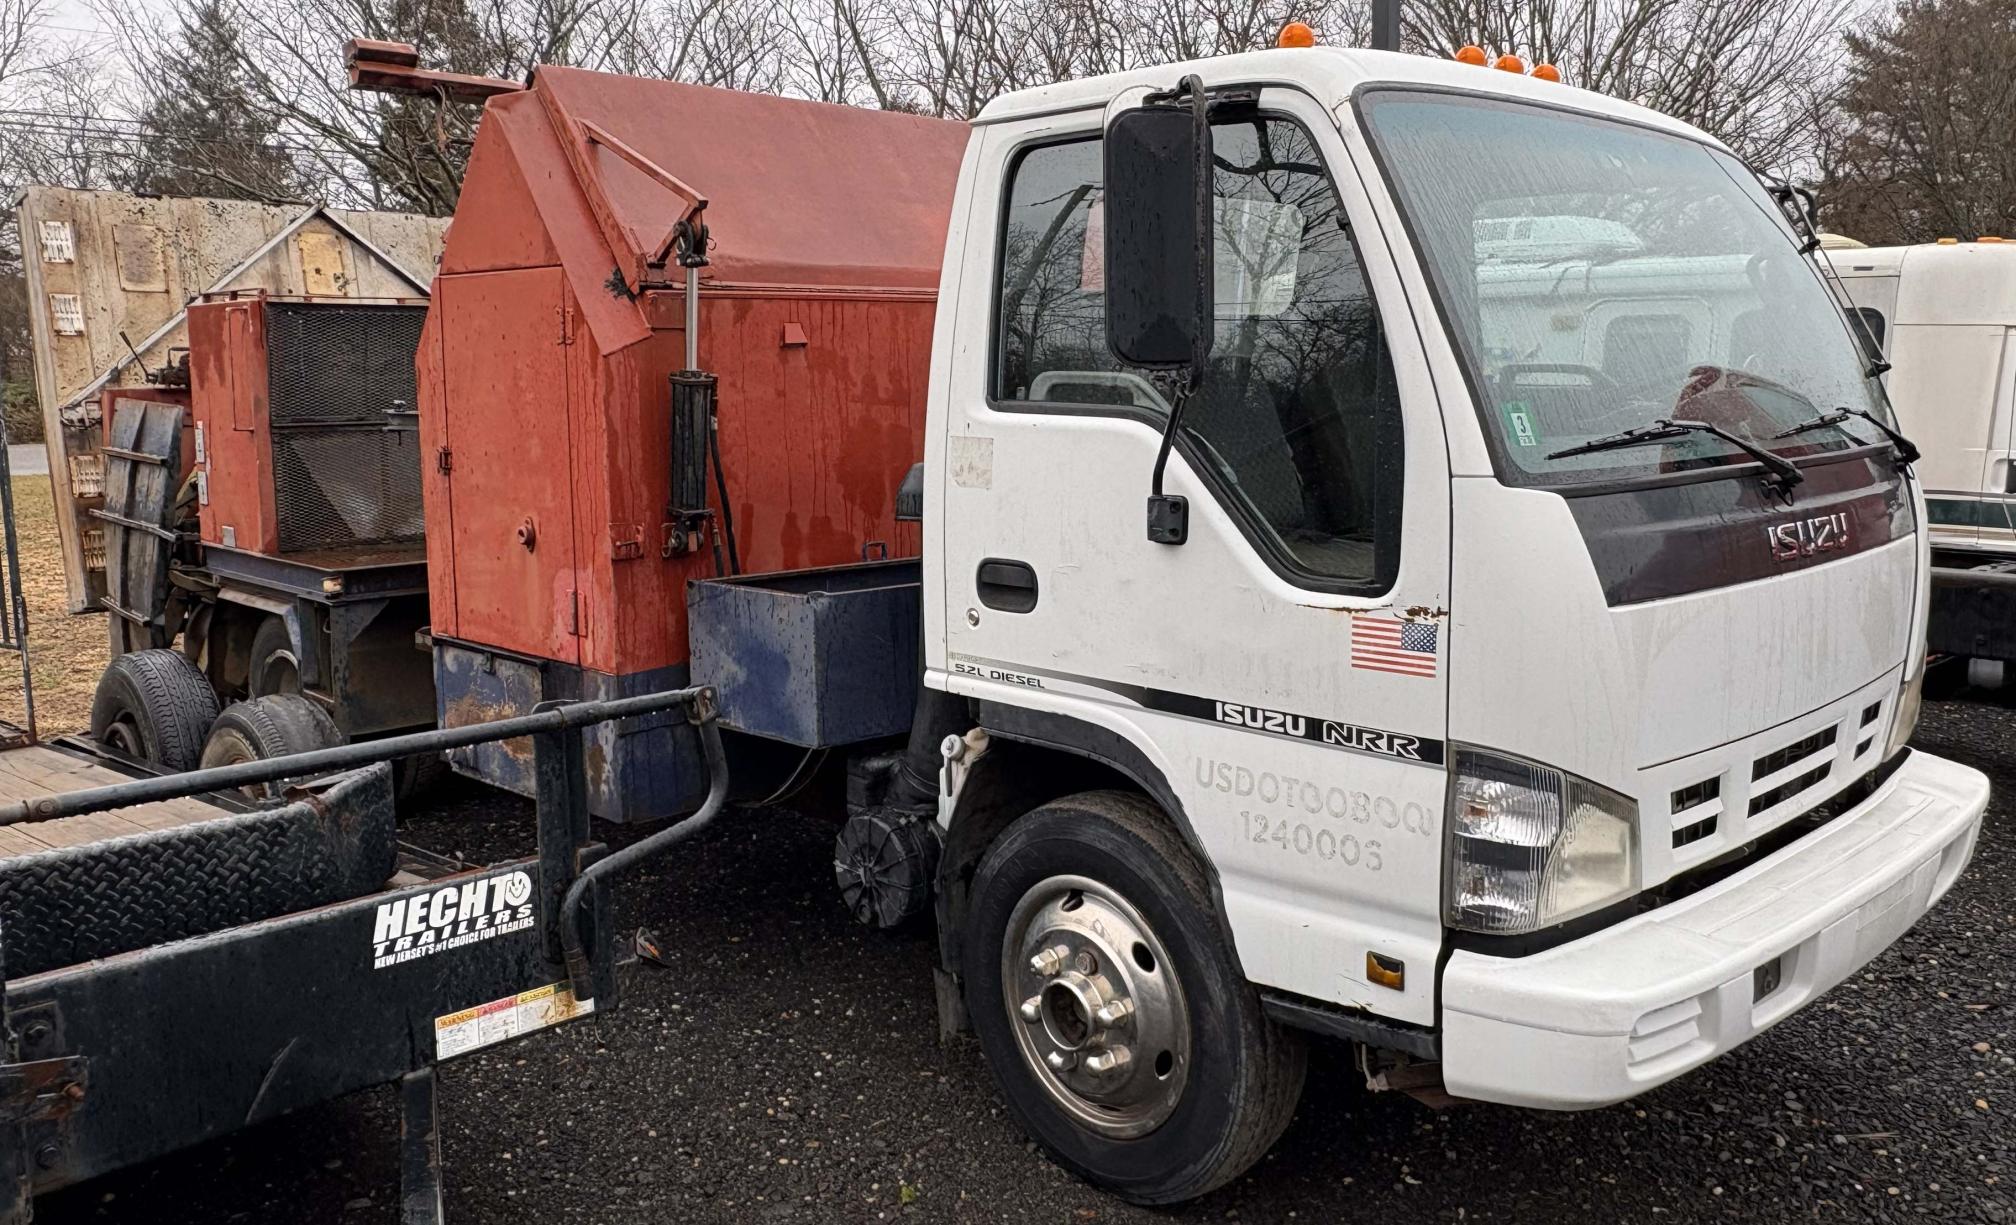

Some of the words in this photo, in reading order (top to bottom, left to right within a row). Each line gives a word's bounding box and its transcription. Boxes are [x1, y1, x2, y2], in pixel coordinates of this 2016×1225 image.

[1767, 512, 1848, 560] ISUZU
[990, 670, 1045, 689] DIESEL
[1215, 701, 1306, 737] ISUZU
[1323, 720, 1422, 760] NRR
[373, 873, 515, 943] HECHT
[373, 903, 533, 957] TRAILERS
[374, 954, 396, 970] NEW
[447, 930, 479, 950] CHOICE
[479, 926, 496, 941] FOR
[496, 915, 535, 936] TRAILERS
